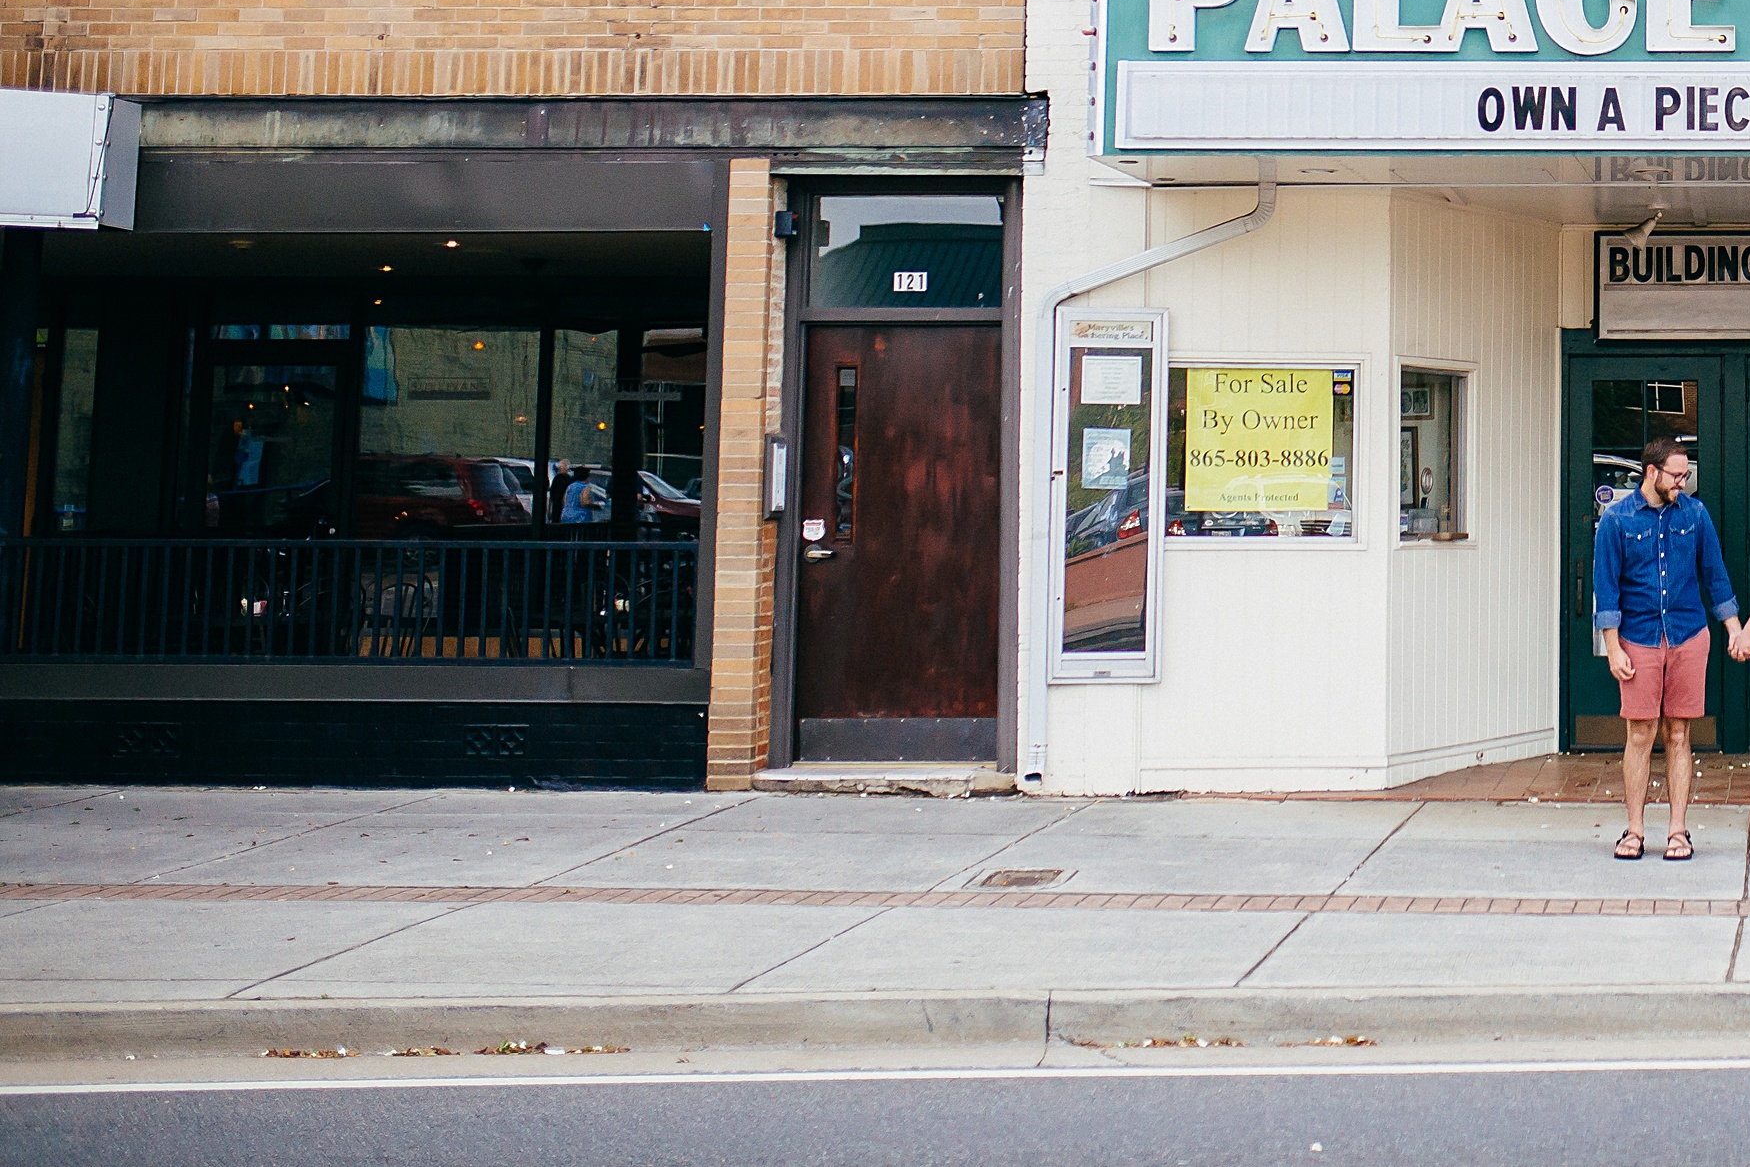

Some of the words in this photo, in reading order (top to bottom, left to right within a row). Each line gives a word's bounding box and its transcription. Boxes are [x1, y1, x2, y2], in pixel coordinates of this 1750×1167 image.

[1477, 87, 1577, 132] OWN
[1596, 87, 1626, 132] A
[897, 273, 923, 290] 121
[1078, 332, 1120, 342] Gahering
[1213, 373, 1253, 394] For
[1260, 373, 1308, 394] Sale
[1202, 409, 1234, 435] By
[1242, 409, 1319, 430] Owner
[1190, 449, 1329, 468] 865-803-8886
[1219, 493, 1251, 503] Agents
[1254, 493, 1299, 502] Protected
